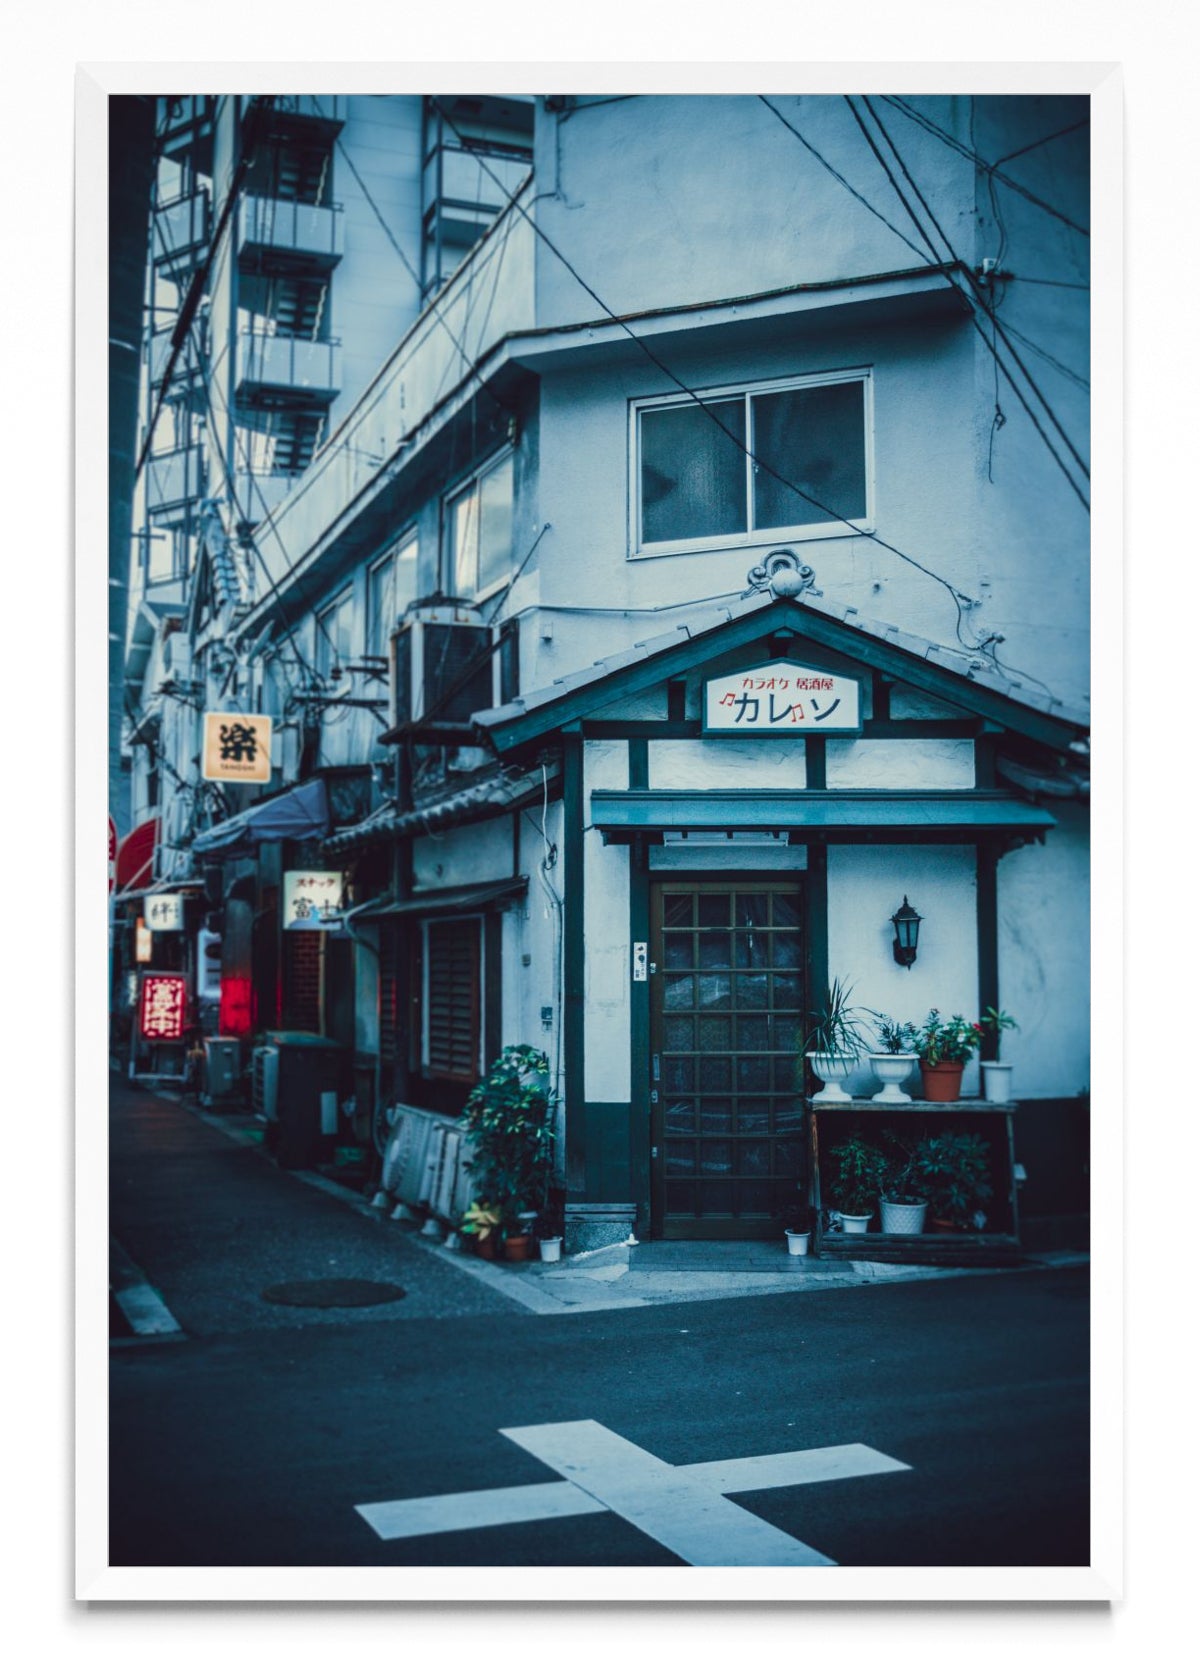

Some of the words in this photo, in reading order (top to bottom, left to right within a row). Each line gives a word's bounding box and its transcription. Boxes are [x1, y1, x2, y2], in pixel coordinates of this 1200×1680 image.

[742, 678, 790, 690] カラオケ
[796, 678, 833, 690] 居酒屋
[219, 723, 257, 762] 楽
[296, 877, 336, 888] スナック
[292, 896, 339, 919] 富士
